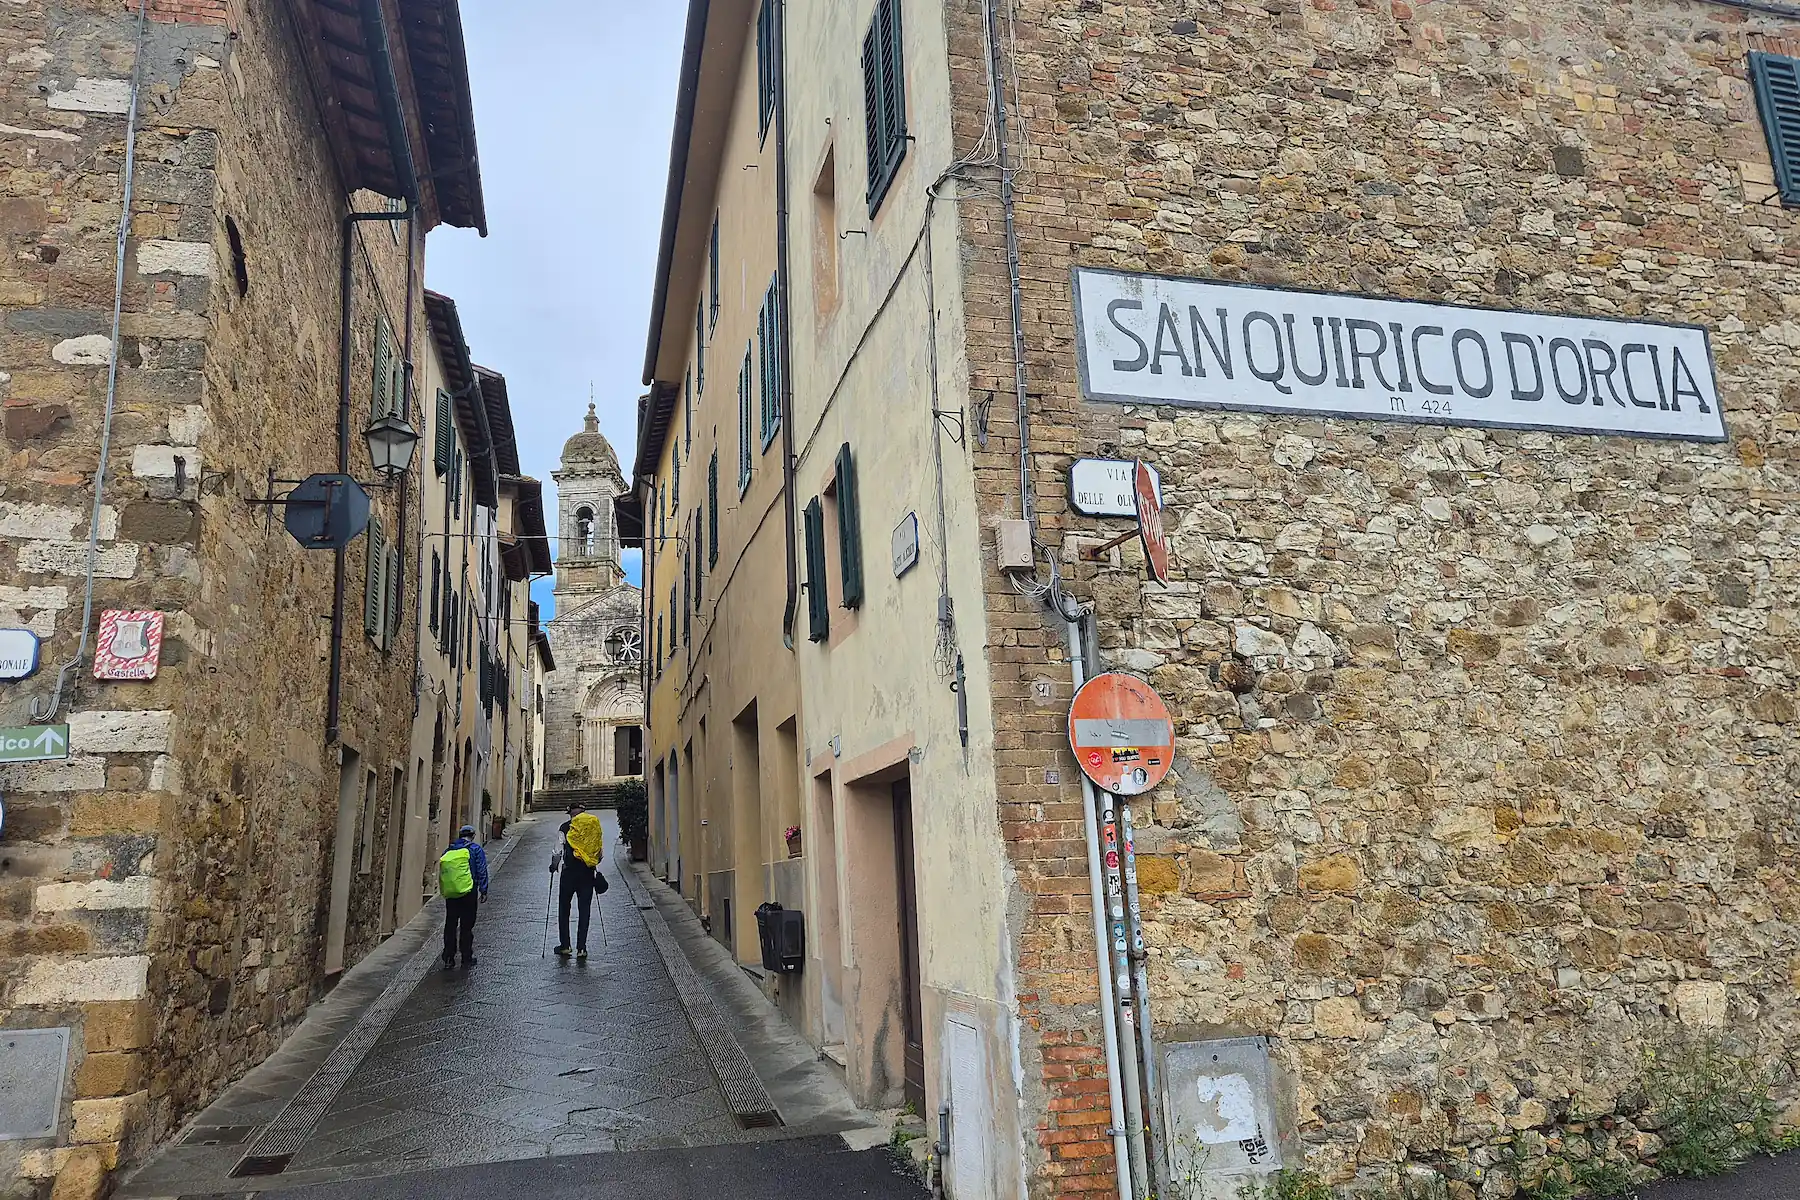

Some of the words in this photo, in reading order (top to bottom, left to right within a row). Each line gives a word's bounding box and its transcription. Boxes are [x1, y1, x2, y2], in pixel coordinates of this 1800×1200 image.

[1106, 298, 1235, 380] SAN
[1242, 310, 1494, 399] QUIRICO
[1500, 331, 1712, 414] D'ORCIA
[1421, 400, 1453, 415] 424
[1106, 468, 1127, 481] VIA
[1078, 492, 1105, 505] DELLE
